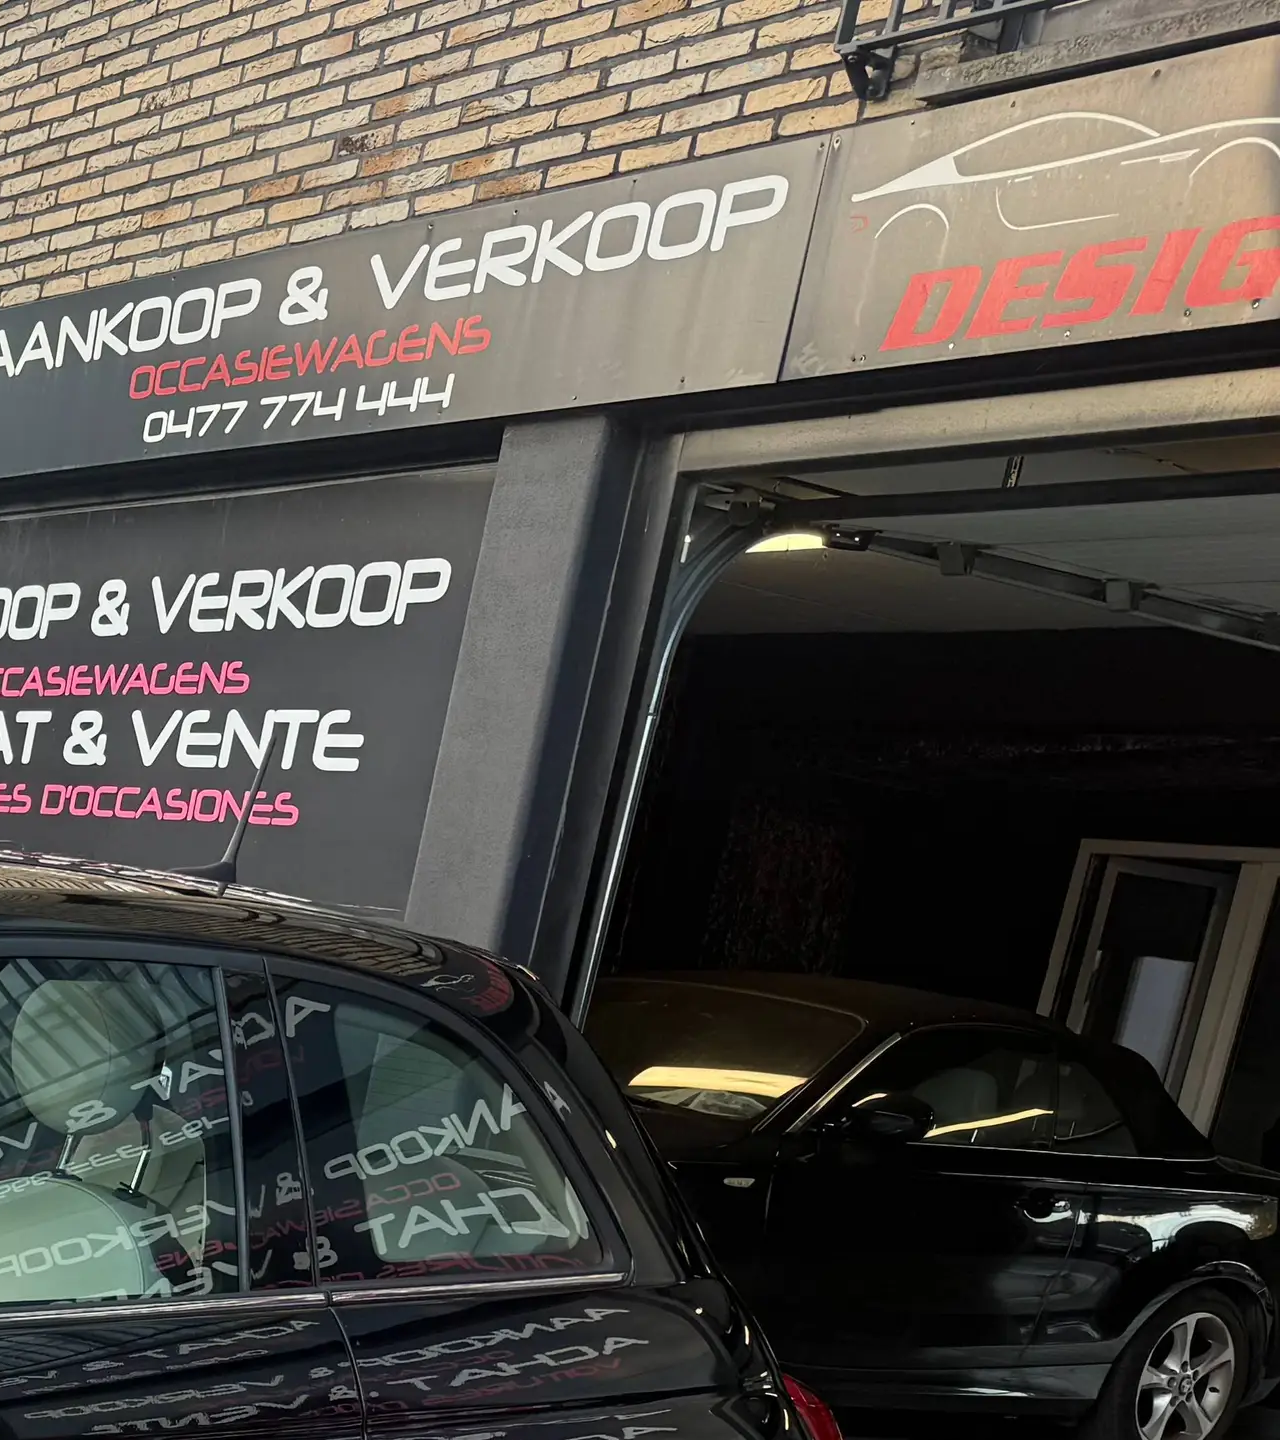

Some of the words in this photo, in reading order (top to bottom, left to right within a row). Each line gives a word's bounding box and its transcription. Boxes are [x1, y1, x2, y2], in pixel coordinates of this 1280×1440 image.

[278, 265, 329, 326] &
[370, 174, 789, 310] VERKOOP
[880, 214, 1280, 352] DESIG
[128, 314, 492, 400] OCCASIEWAGENS
[142, 400, 248, 443] 0477
[260, 388, 346, 429] 774
[356, 373, 455, 416] 444
[90, 578, 130, 637] &
[151, 557, 452, 635] VERKOOP
[63, 710, 107, 766] &
[131, 709, 365, 772] VENTE
